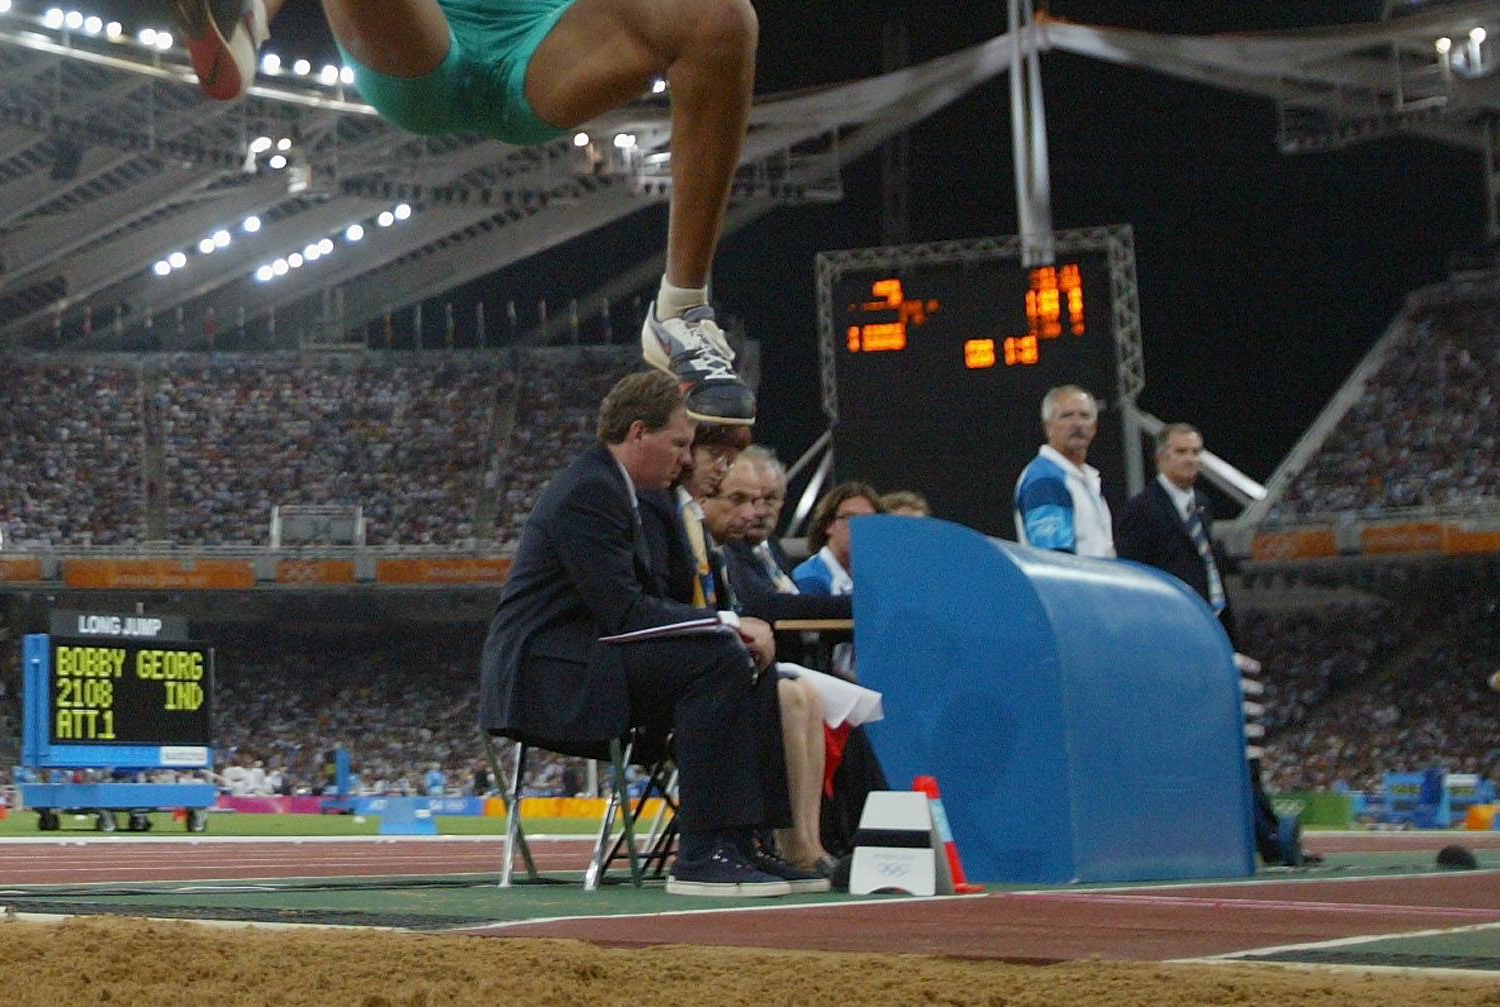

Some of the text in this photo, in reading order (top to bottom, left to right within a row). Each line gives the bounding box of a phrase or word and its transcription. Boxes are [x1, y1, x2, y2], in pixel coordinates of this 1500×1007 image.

[78, 615, 162, 636] LONG JUMP
[56, 646, 204, 680] BOBBY GEORG
[56, 678, 204, 710] 2108 IND
